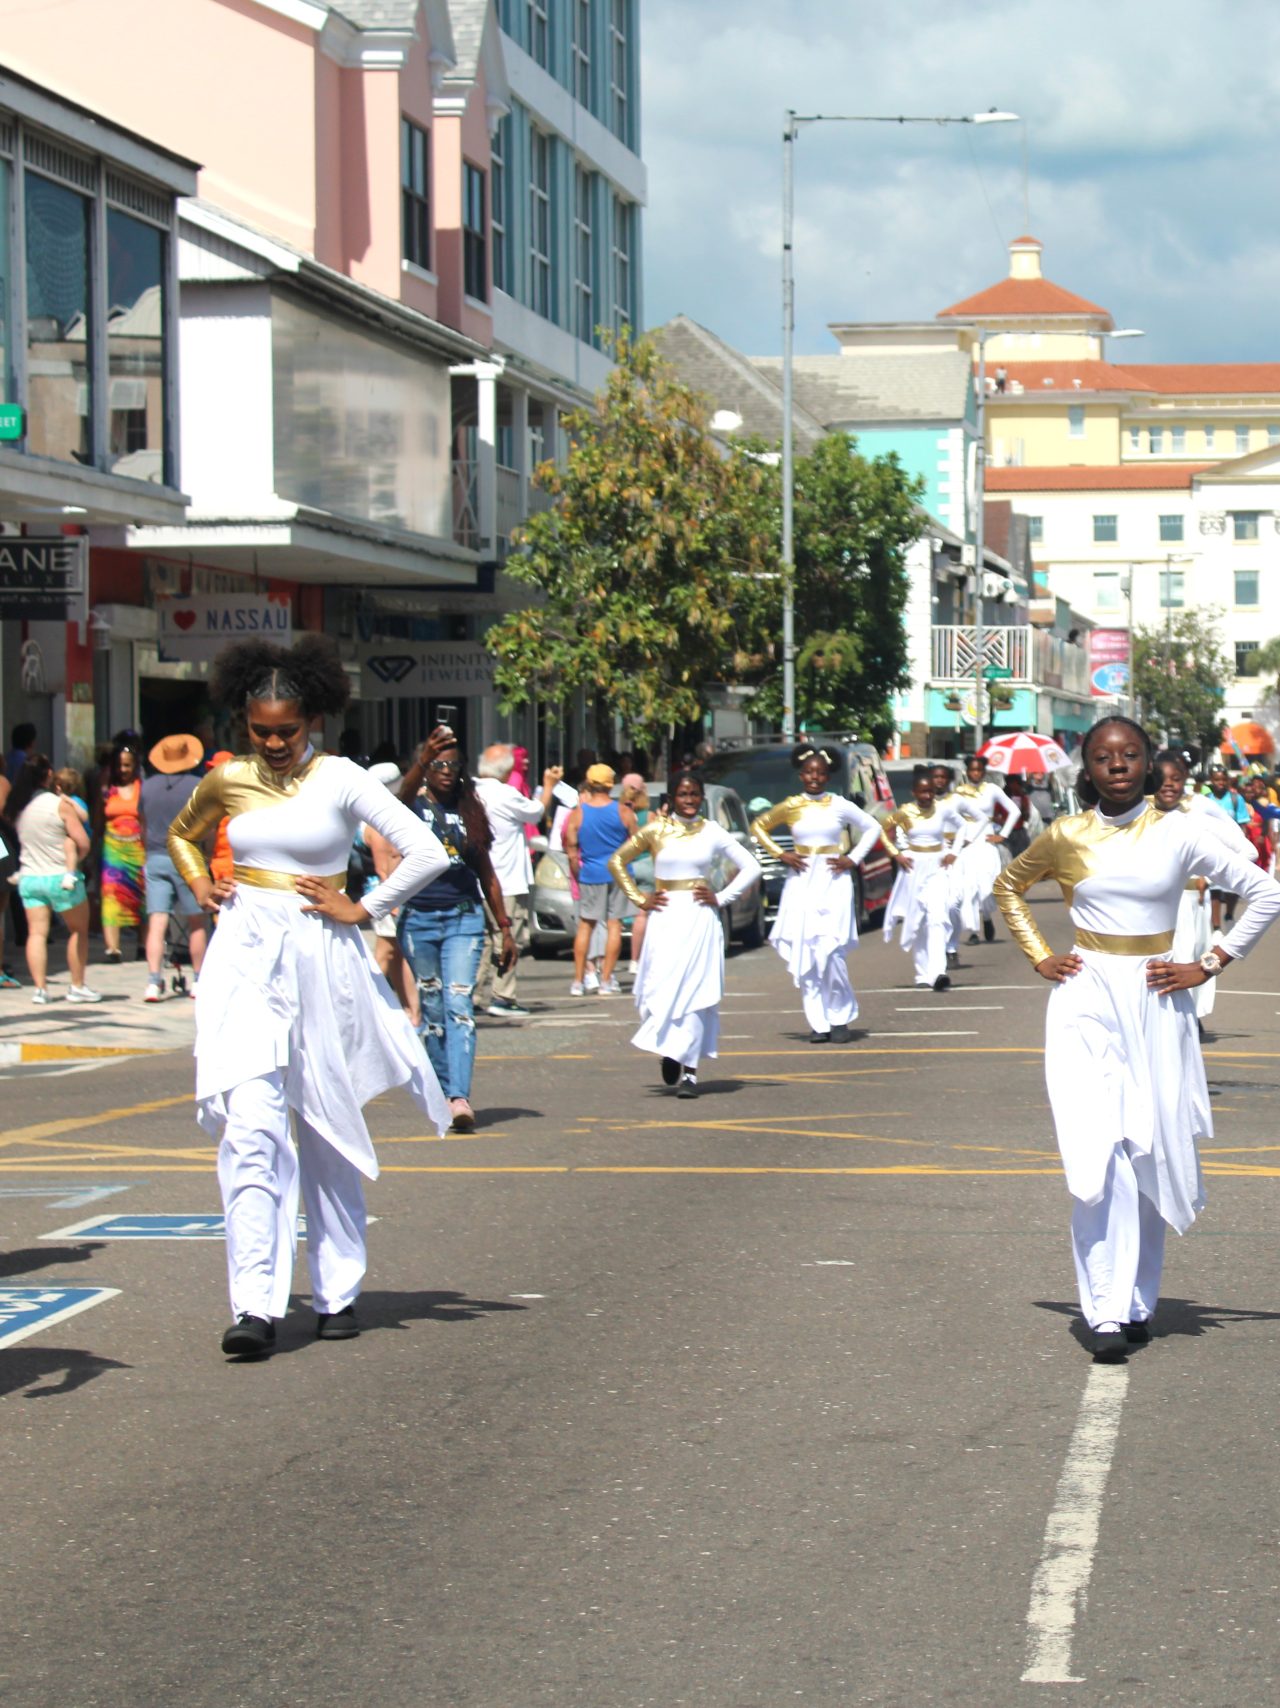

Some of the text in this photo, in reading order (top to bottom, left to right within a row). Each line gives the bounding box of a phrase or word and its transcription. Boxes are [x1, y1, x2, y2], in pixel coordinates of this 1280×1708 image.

[161, 608, 288, 631] I NASSAU
[421, 653, 495, 665] INFINITY
[421, 668, 493, 682] JEWELRY
